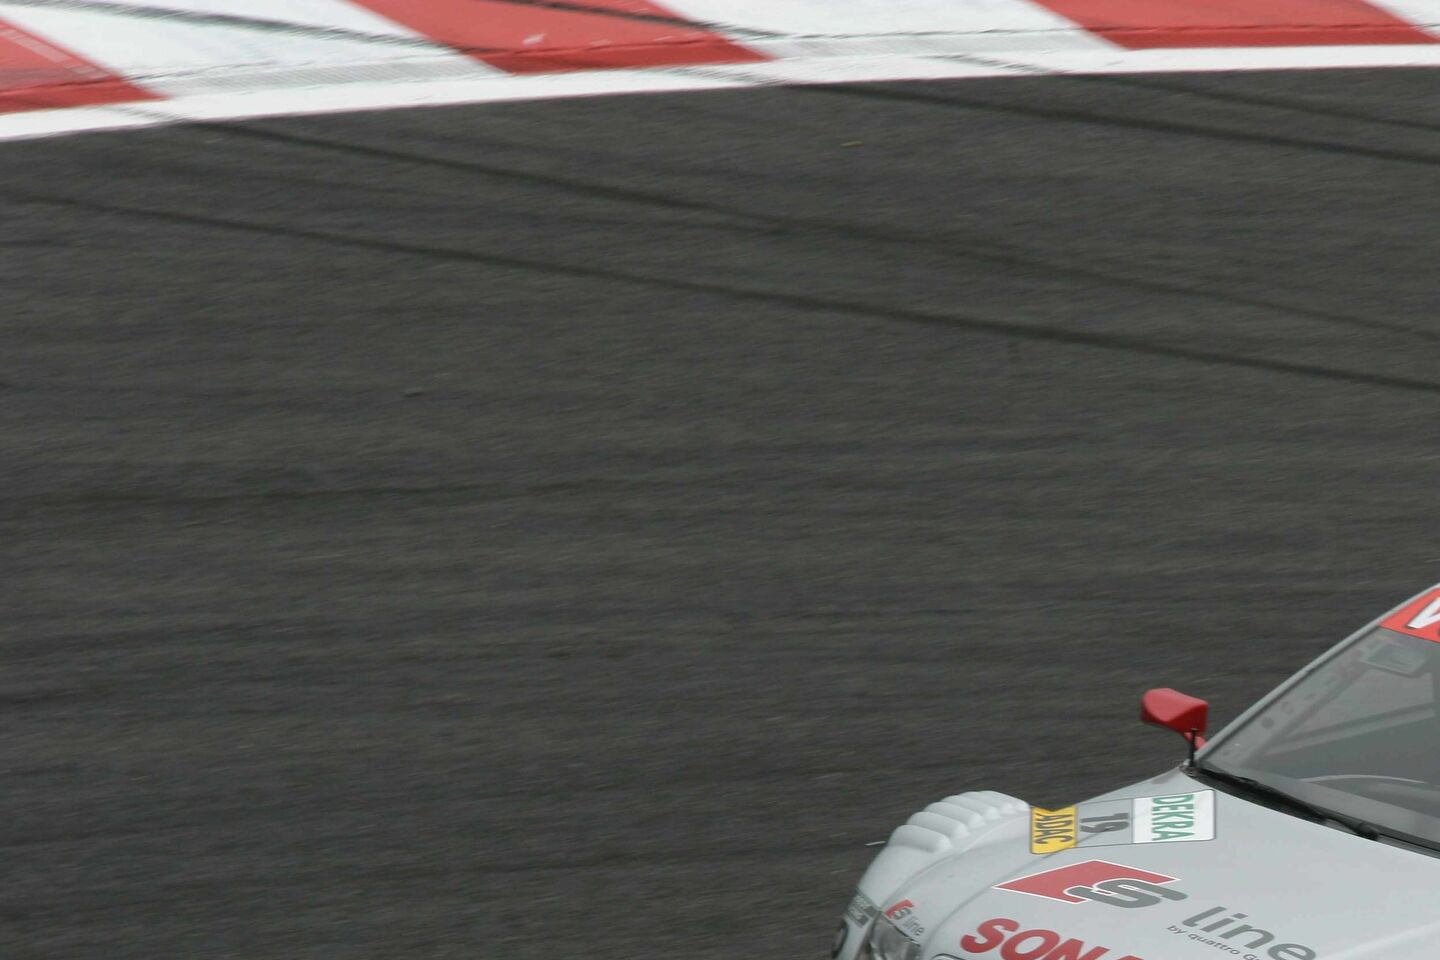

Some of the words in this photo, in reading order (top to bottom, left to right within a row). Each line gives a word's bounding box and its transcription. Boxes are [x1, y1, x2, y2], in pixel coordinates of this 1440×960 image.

[1034, 812, 1073, 845] ADAC
[1079, 812, 1130, 834] 19
[1150, 794, 1196, 841] DEKRA
[1165, 924, 1187, 936] by
[1187, 931, 1241, 955] quattro
